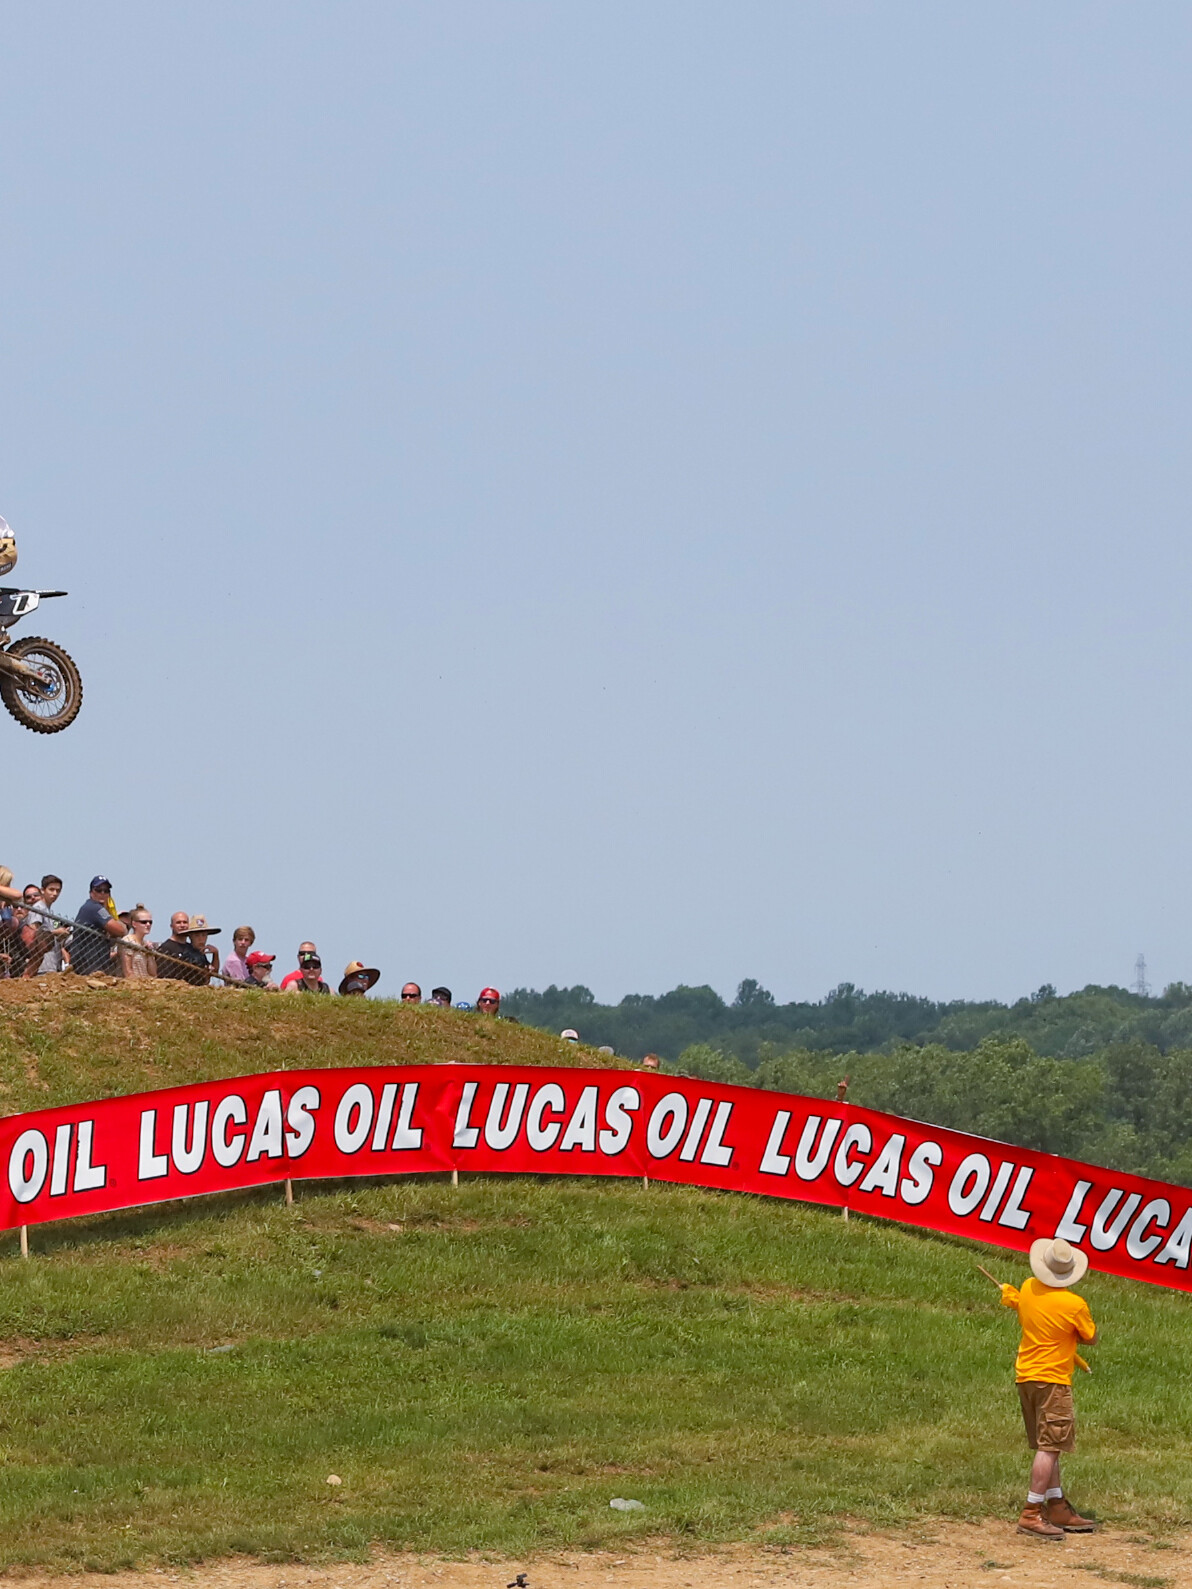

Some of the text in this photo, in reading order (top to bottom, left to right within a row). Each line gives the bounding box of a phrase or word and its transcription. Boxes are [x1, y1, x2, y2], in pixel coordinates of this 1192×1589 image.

[7, 1119, 108, 1204] OIL
[137, 1081, 424, 1181] LUCAS OIL
[451, 1081, 735, 1168] LUCAS OIL
[758, 1109, 1036, 1232] LUCAS OIL
